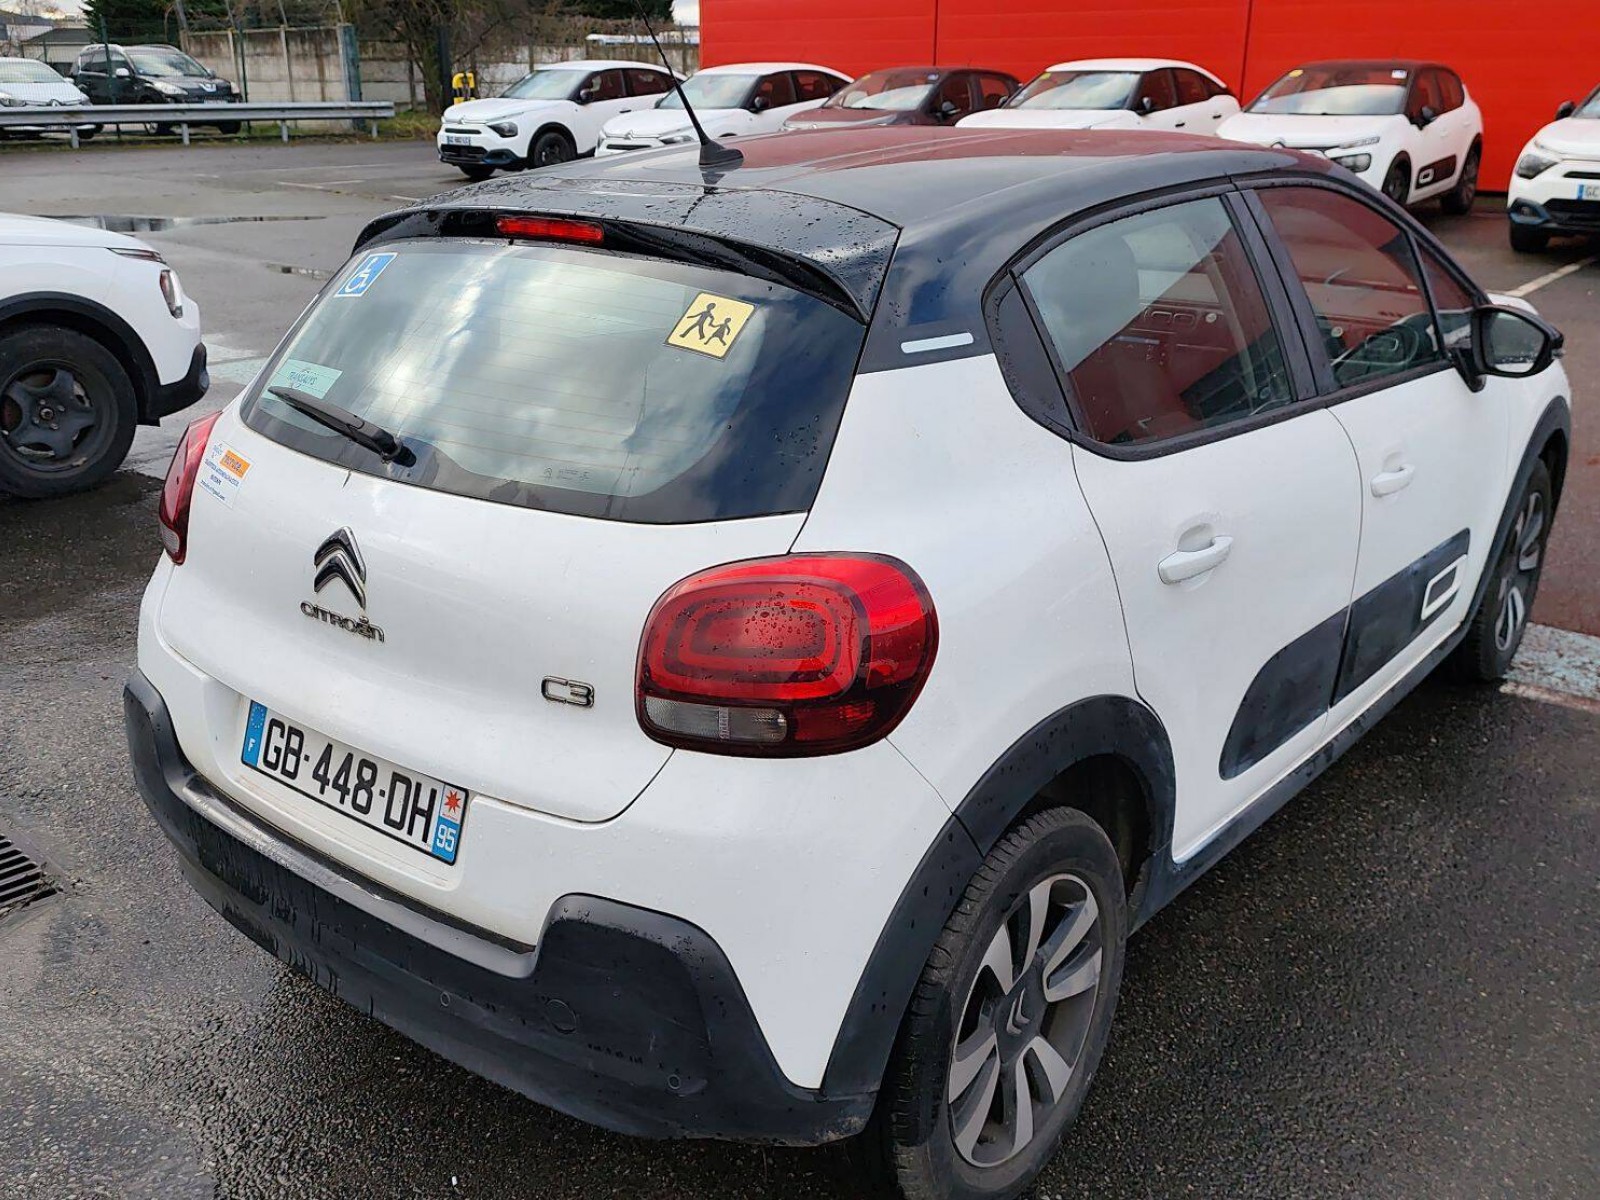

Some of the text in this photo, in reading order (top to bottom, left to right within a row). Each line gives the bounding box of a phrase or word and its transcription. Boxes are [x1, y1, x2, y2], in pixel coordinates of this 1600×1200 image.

[541, 675, 595, 708] C3
[247, 737, 256, 752] F
[436, 823, 457, 852] 95
